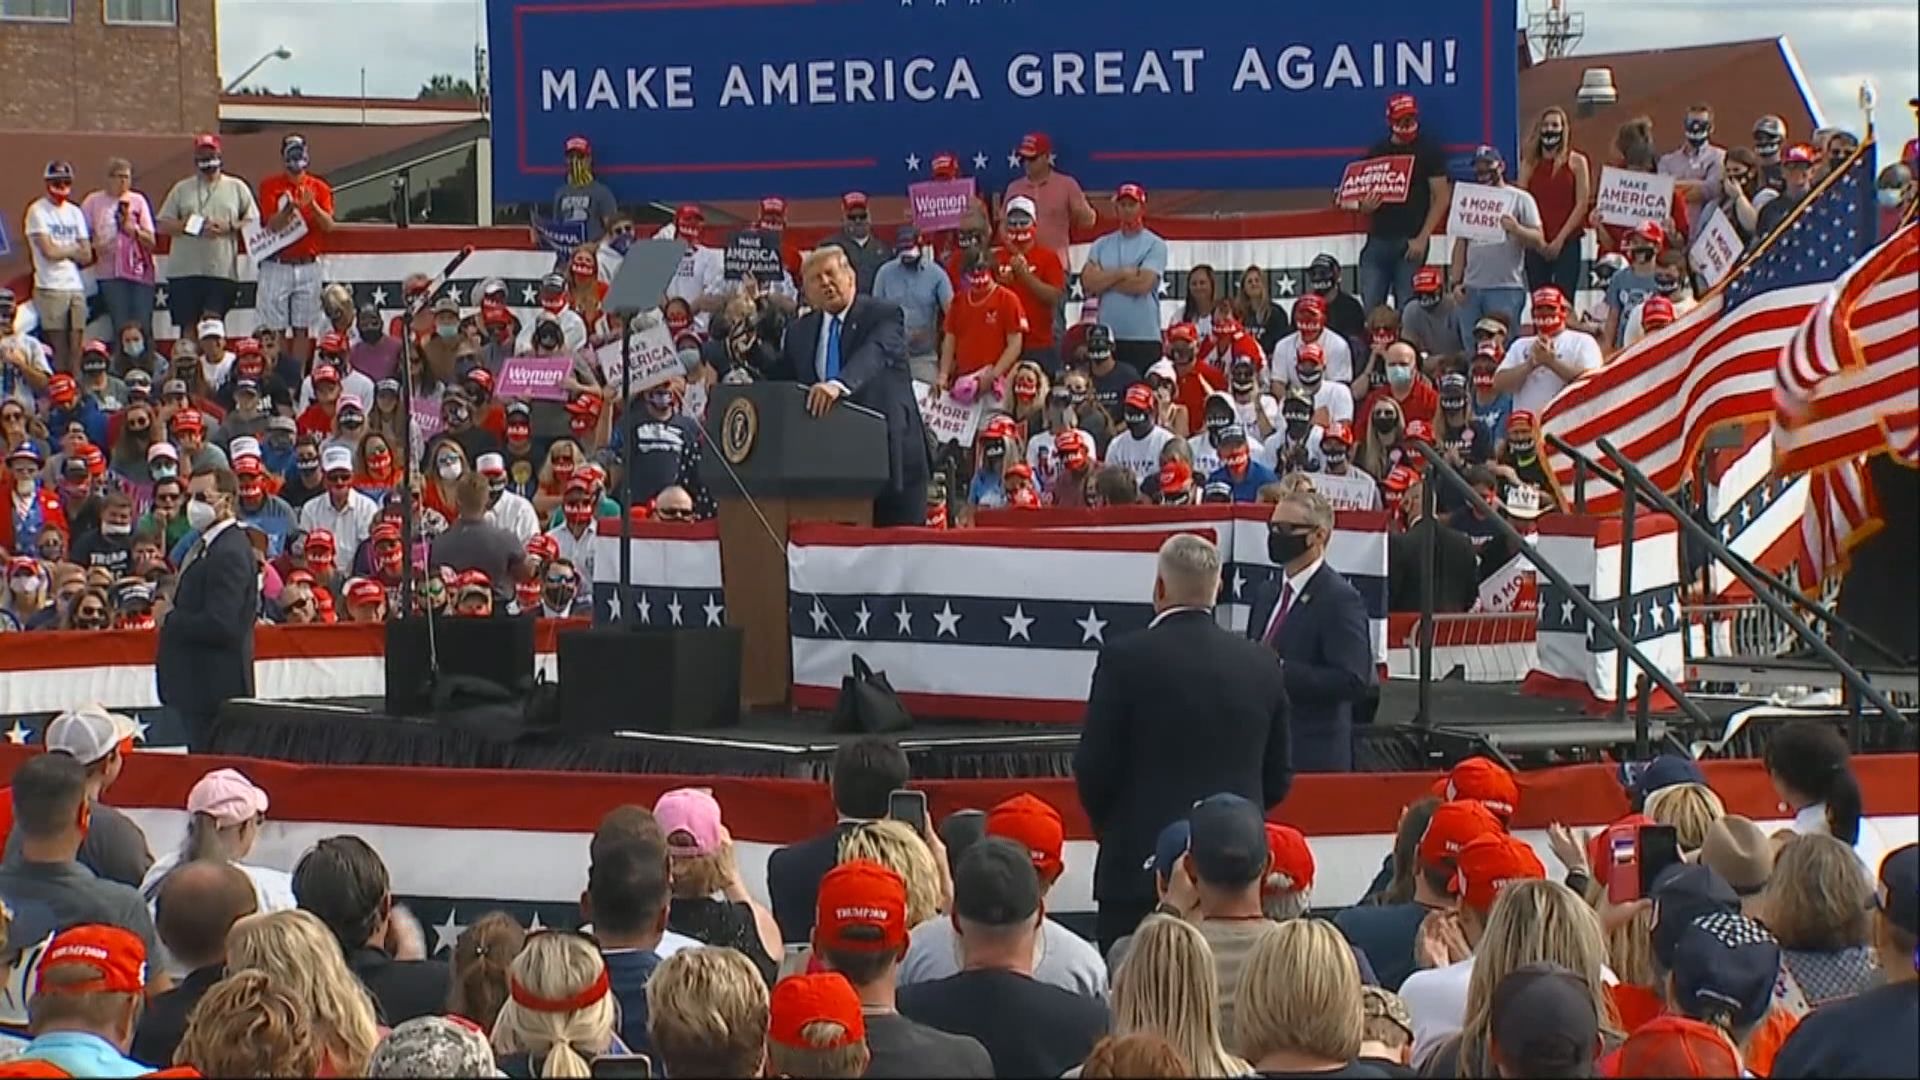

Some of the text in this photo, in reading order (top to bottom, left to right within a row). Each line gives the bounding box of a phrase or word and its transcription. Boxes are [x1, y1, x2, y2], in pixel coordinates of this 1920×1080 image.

[542, 39, 1457, 110] MAKE AMERICA GREAT AGAIN!
[1344, 171, 1406, 188] AMERICA
[1619, 179, 1648, 191] MAKE
[1373, 183, 1405, 194] AGAIN
[916, 193, 967, 213] Women
[1460, 197, 1504, 214] 4 MORE
[1601, 187, 1667, 209] AMERICA
[1459, 212, 1499, 228] YEARS!
[1631, 208, 1667, 220] AGAIN
[727, 245, 779, 263] AMERICA
[509, 365, 564, 382] Women
[919, 398, 971, 421] 4 MORE
[925, 414, 967, 434] EARS!
